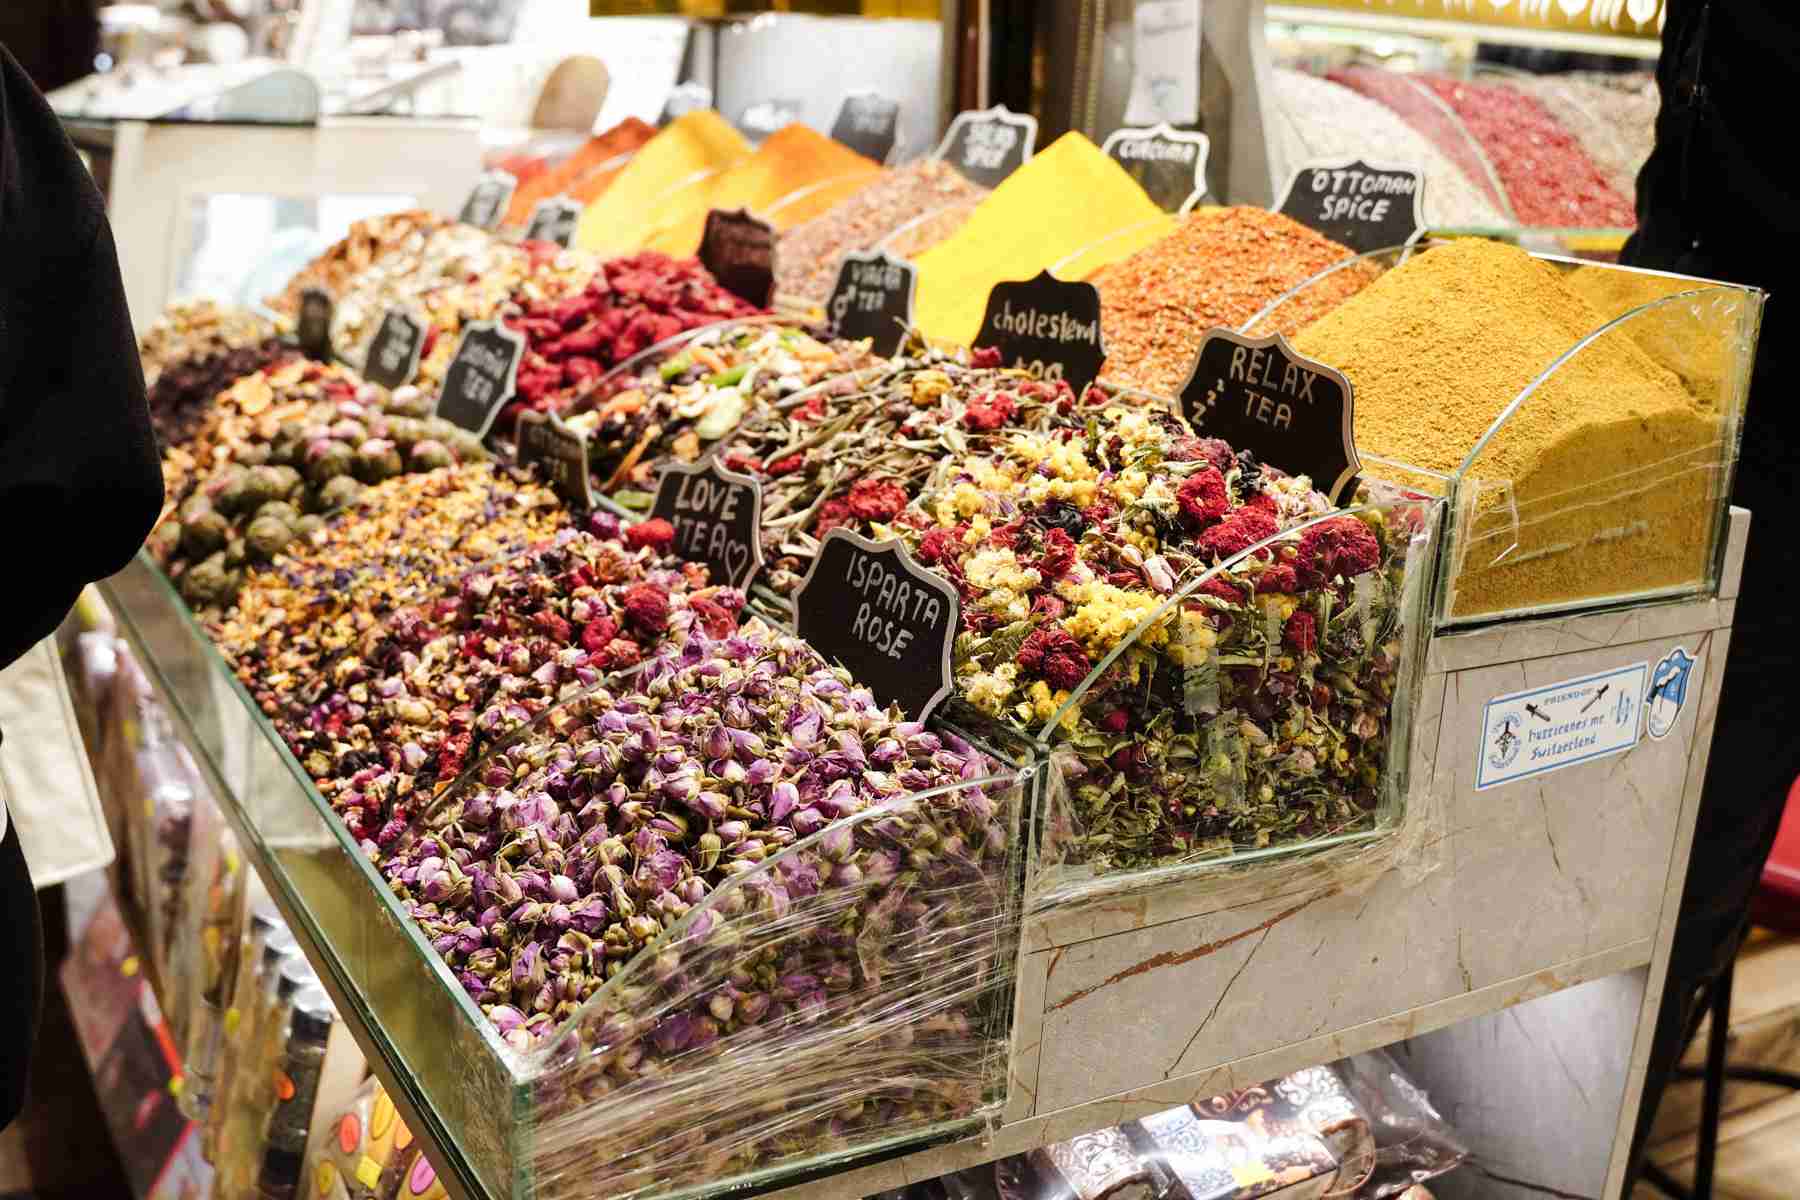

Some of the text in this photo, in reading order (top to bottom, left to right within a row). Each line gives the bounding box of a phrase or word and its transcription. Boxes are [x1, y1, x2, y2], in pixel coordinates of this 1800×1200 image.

[1230, 346, 1317, 405] RELAX
[1244, 388, 1292, 431] TEA
[675, 475, 744, 521] LOVE
[846, 552, 941, 630] ISPARTA
[852, 602, 914, 660] ROSE
